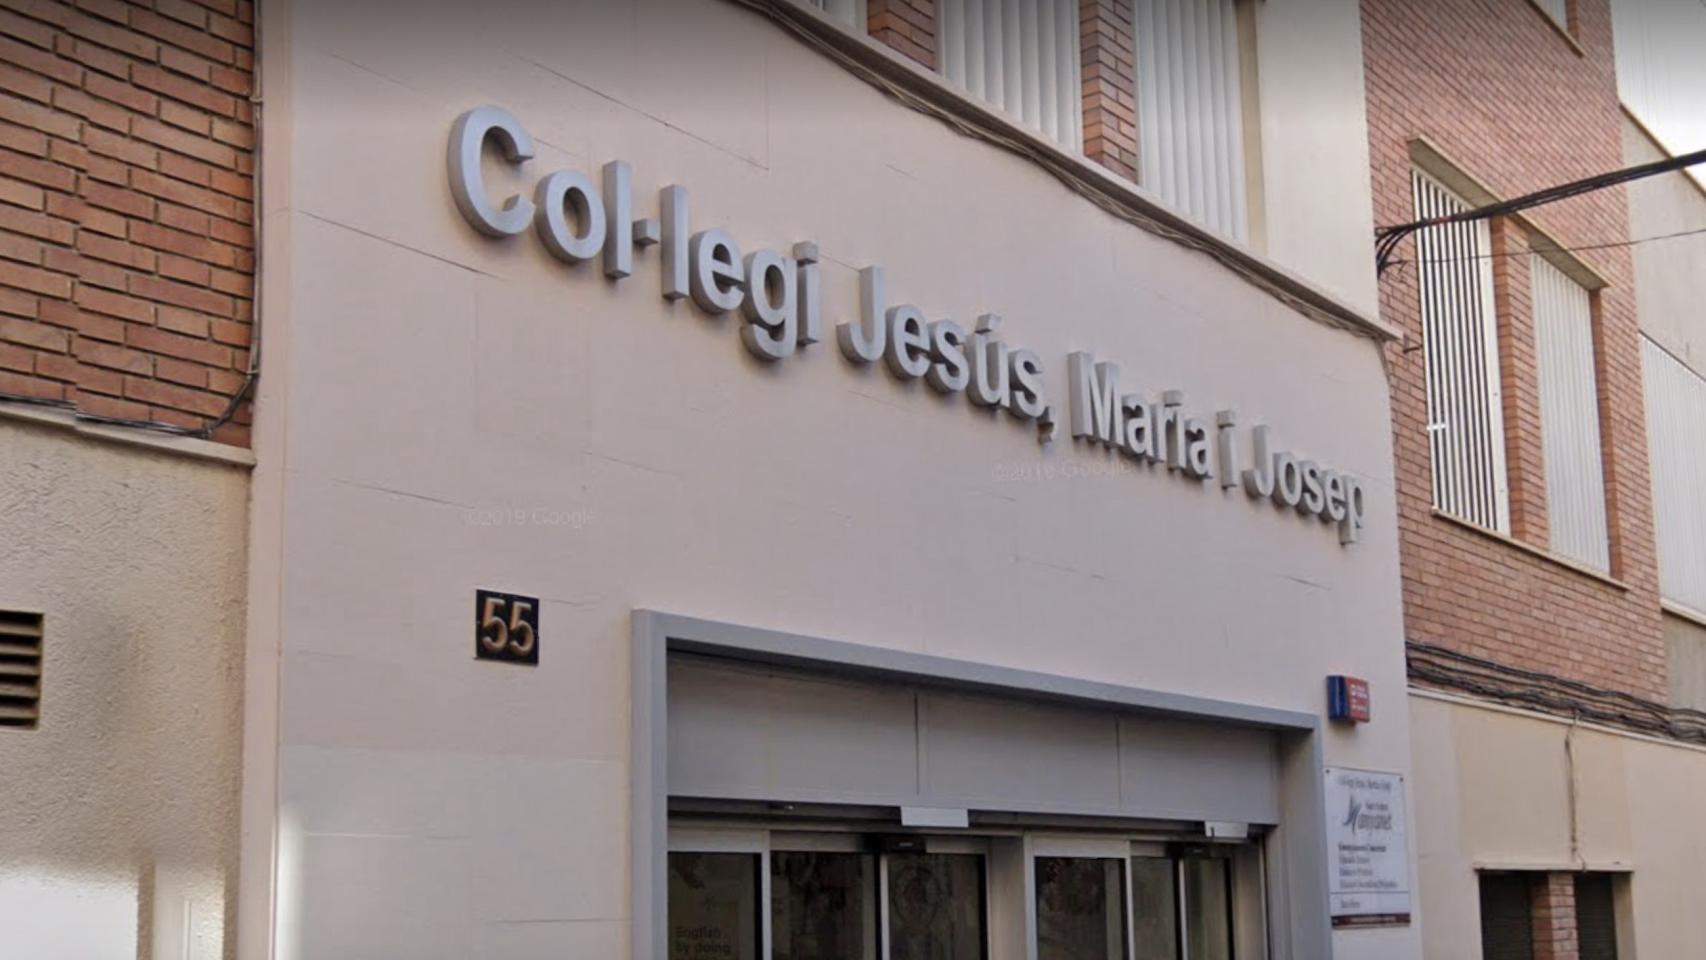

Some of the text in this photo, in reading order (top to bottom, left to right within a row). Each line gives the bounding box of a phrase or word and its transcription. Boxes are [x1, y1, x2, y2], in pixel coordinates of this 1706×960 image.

[836, 266, 1057, 444] Jesús,
[1216, 410, 1237, 488] i
[1243, 425, 1364, 545] Josep
[482, 597, 535, 656] 55
